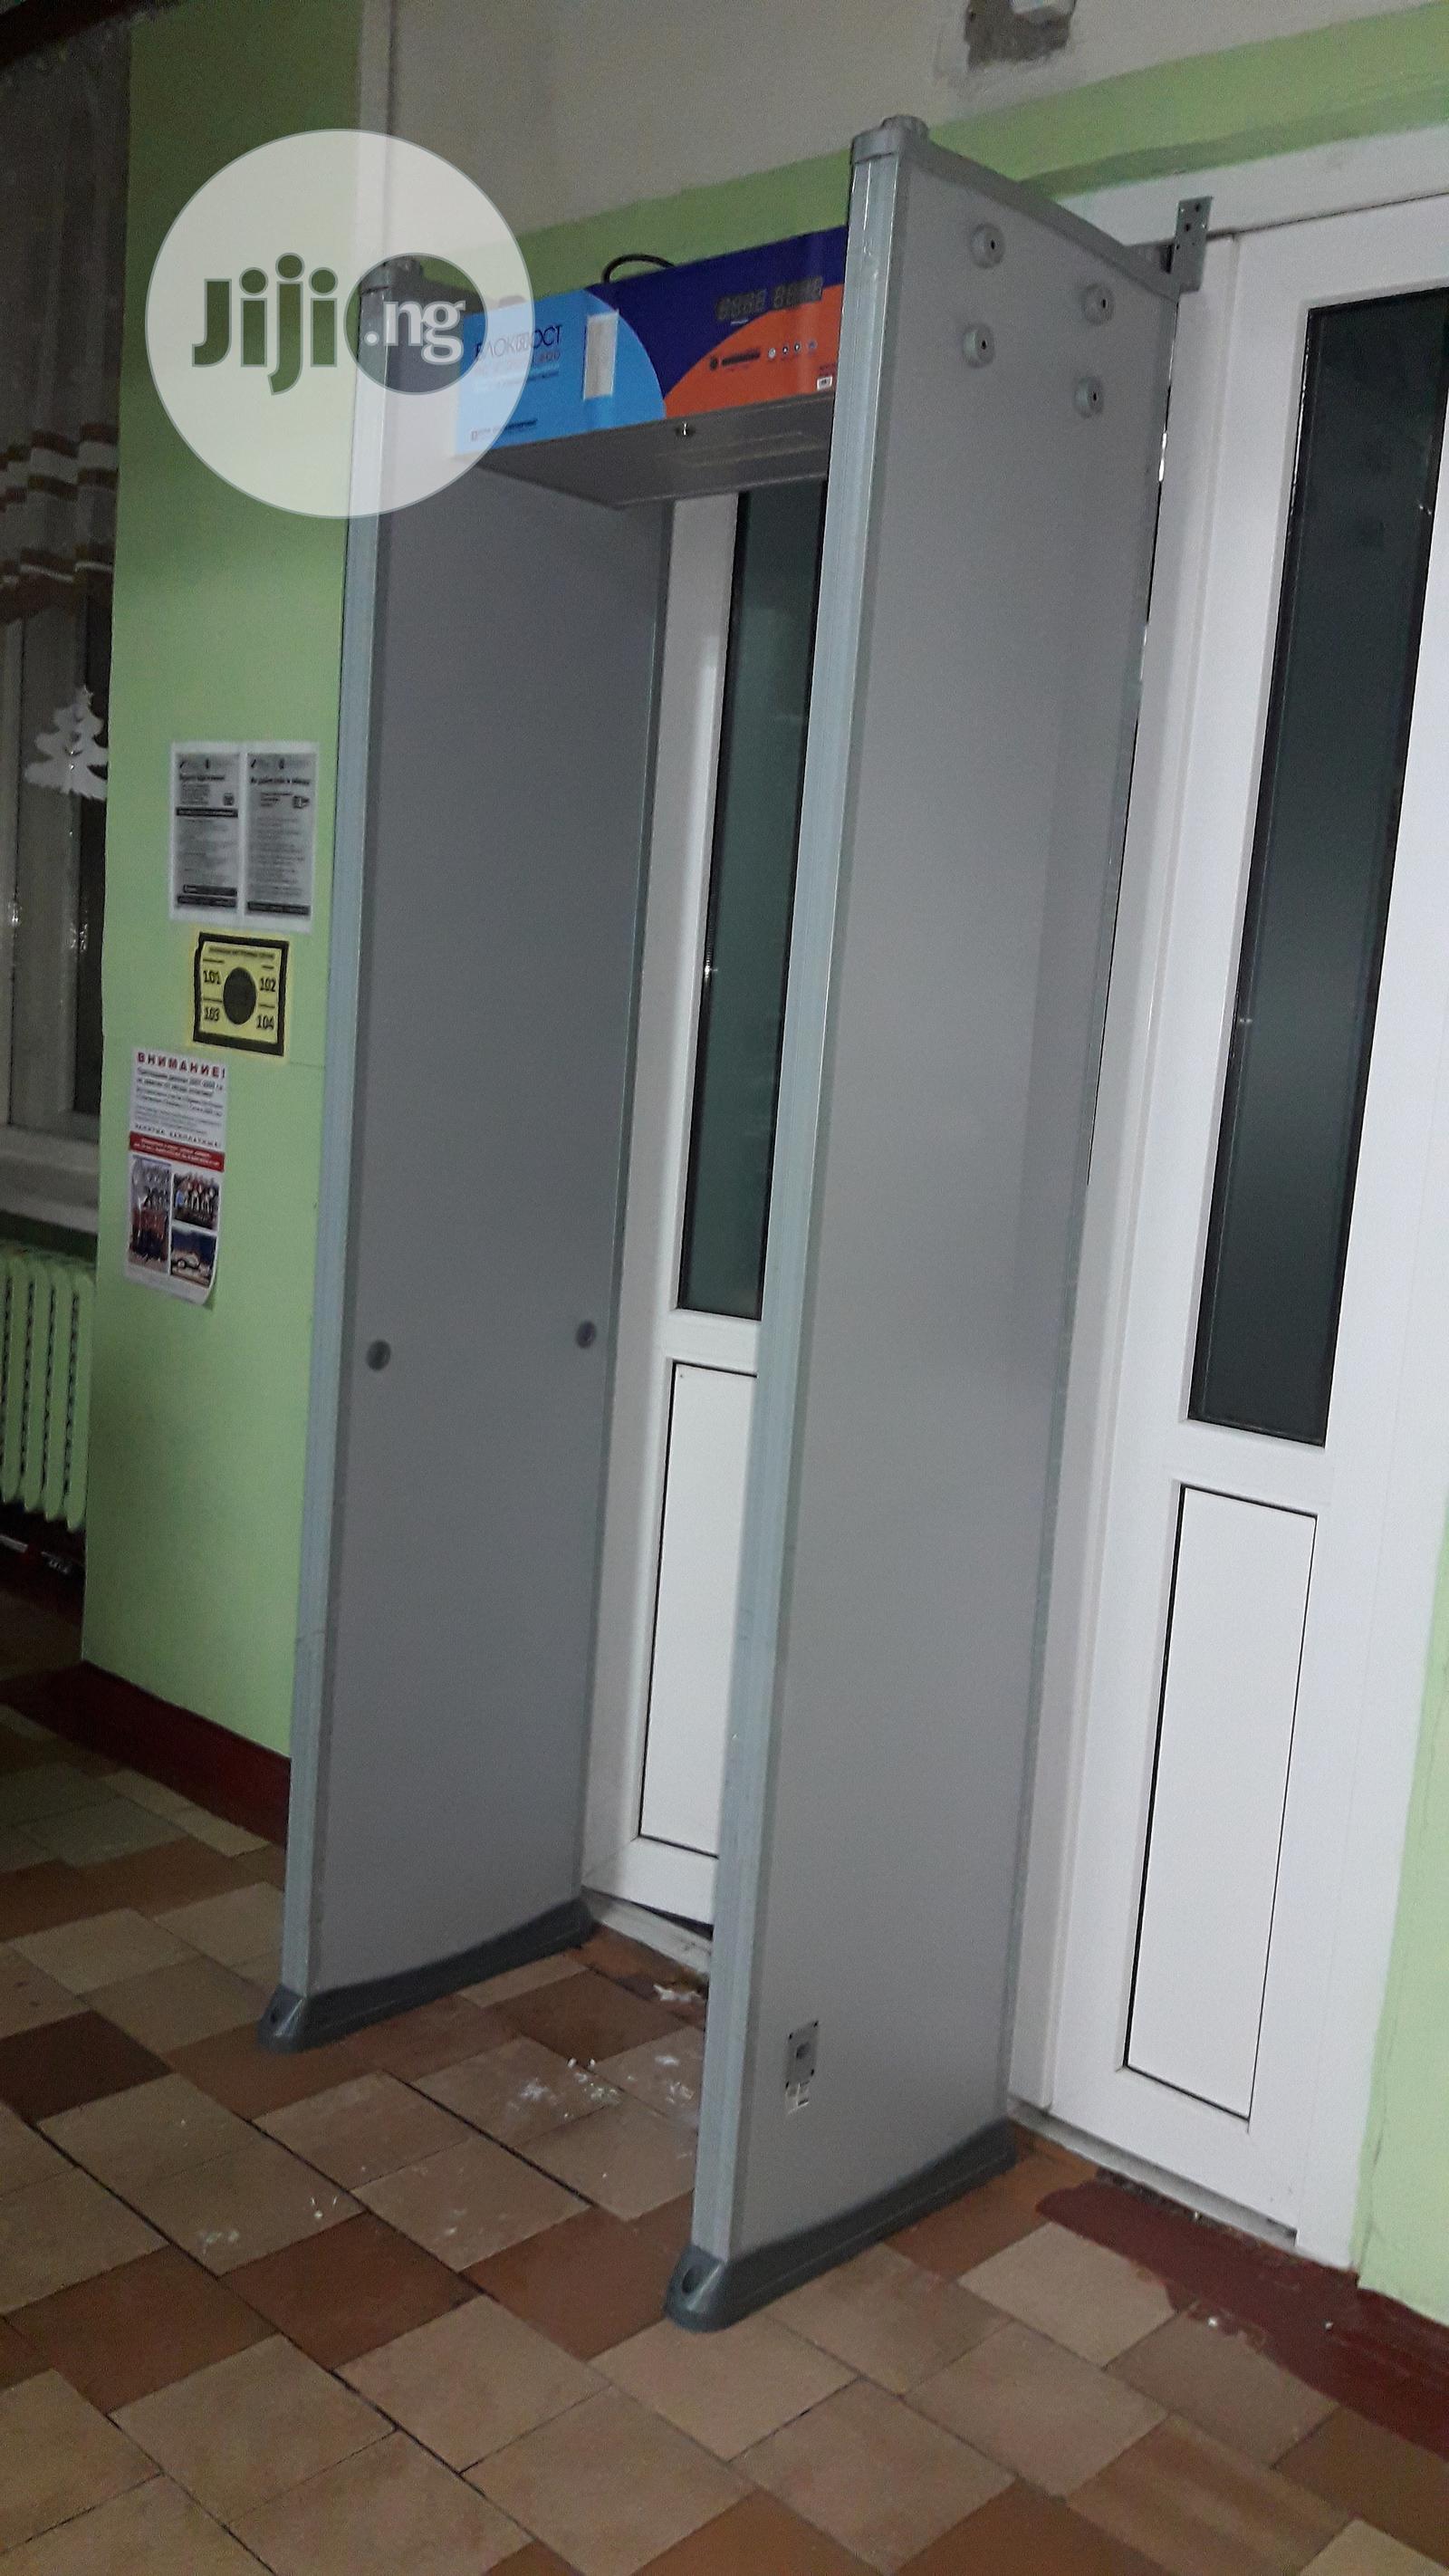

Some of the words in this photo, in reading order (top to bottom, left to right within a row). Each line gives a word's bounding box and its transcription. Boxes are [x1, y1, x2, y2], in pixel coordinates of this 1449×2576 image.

[203, 970, 221, 985] 101
[260, 978, 276, 993] 102
[204, 1006, 220, 1022] 103
[256, 1014, 274, 1030] 104
[138, 1053, 225, 1078] ВНИМАНИЕ!
